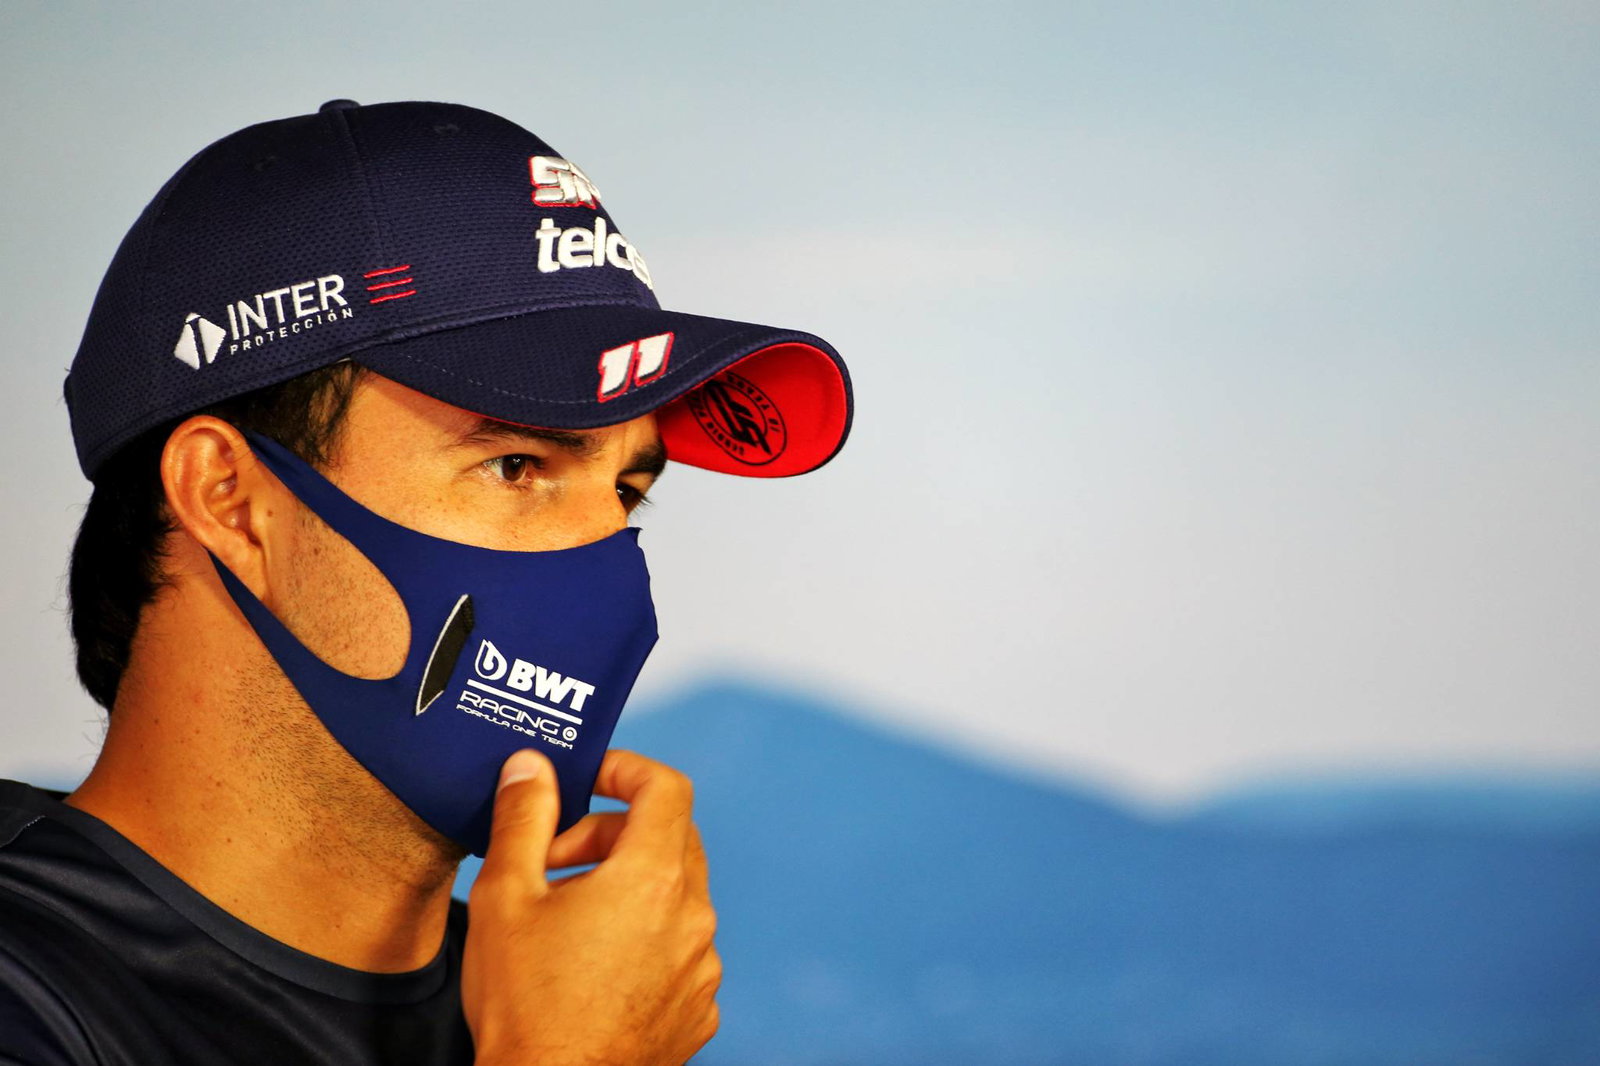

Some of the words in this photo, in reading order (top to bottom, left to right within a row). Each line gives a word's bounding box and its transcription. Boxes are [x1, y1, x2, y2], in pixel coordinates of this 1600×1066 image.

[535, 216, 653, 290] telce
[226, 274, 348, 341] INTER
[229, 308, 353, 356] PROTECCIÓN
[598, 331, 675, 403] 11
[506, 658, 596, 712] BWT
[456, 704, 511, 728] FORMULA
[512, 723, 537, 738] ONE
[541, 733, 574, 750] TEAM
[459, 690, 561, 736] RACING
